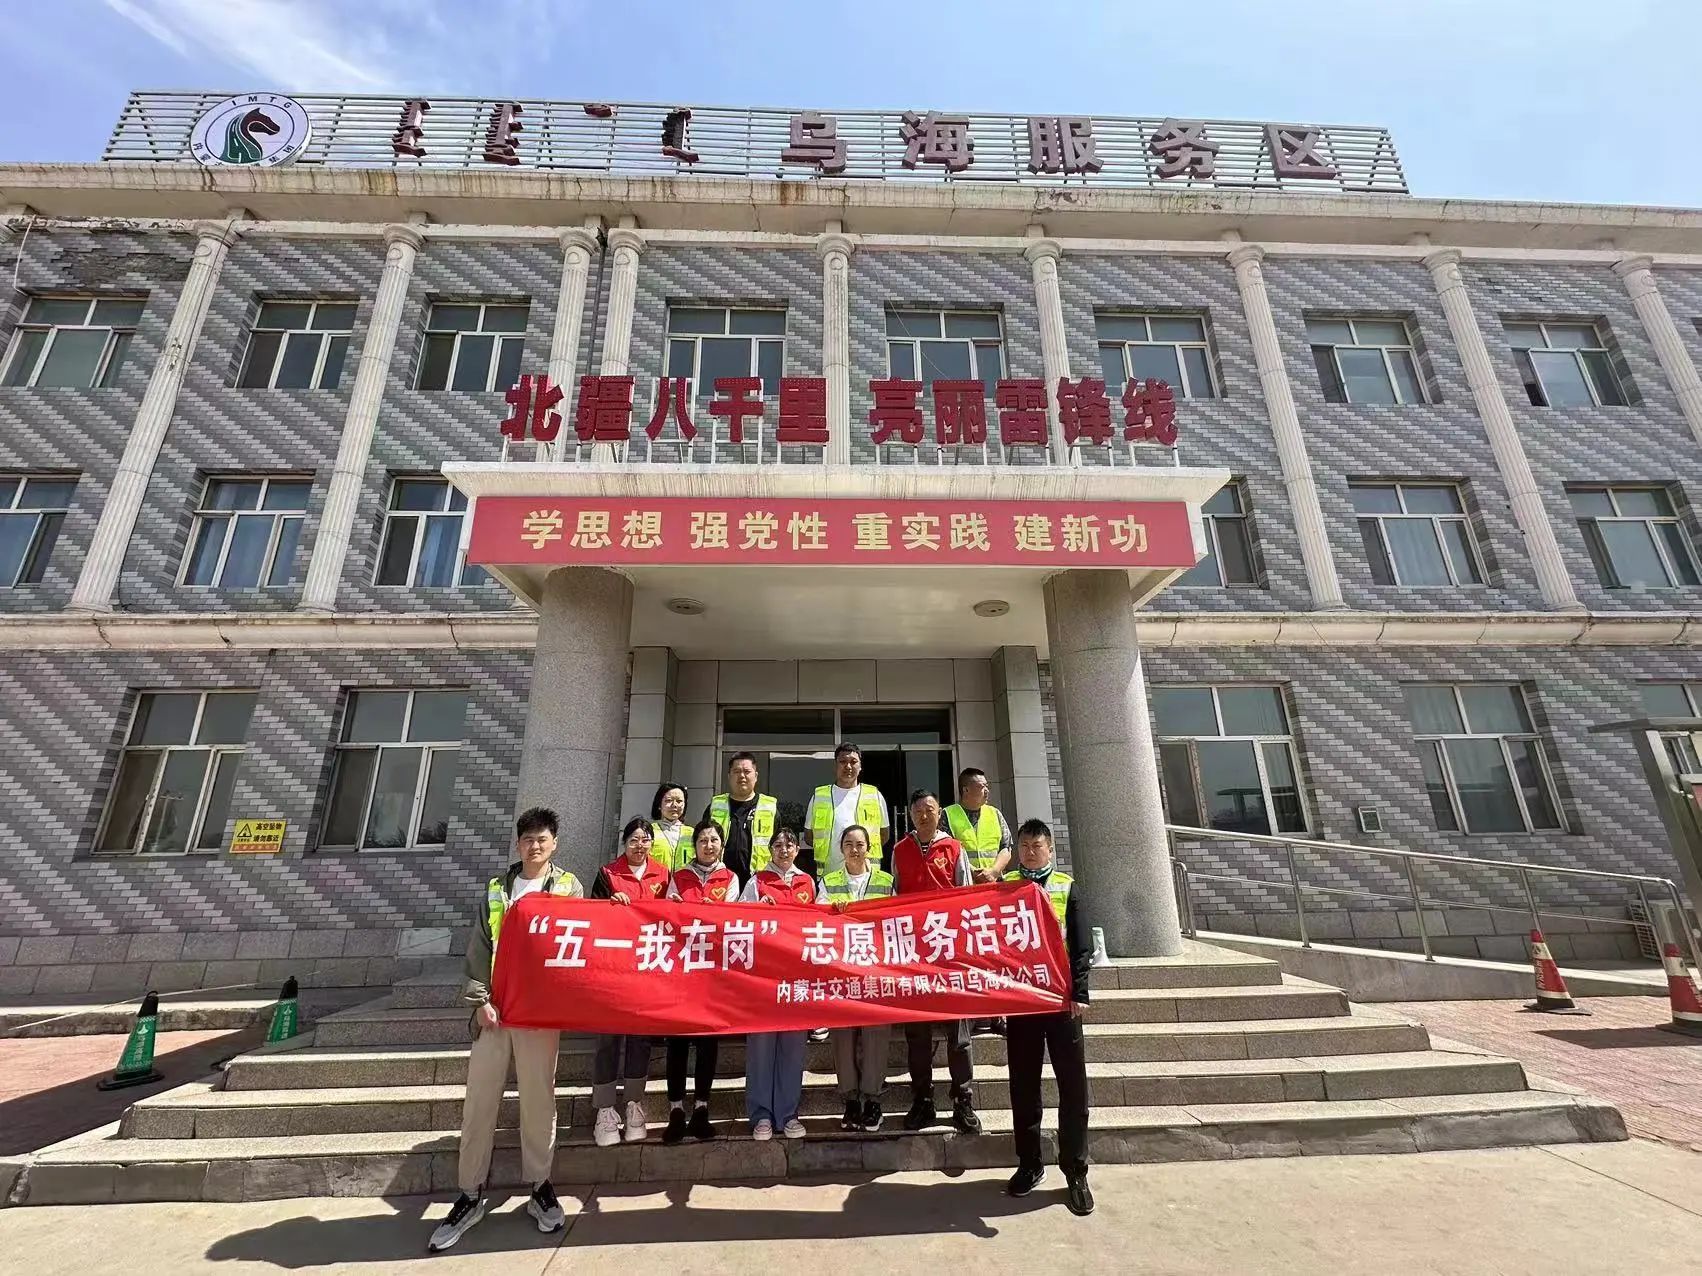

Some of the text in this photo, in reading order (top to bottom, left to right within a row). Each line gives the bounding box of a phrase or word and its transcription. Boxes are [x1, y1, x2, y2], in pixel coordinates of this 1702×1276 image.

[231, 96, 293, 109] IMTG
[782, 110, 1337, 179] 乌海服务区
[501, 375, 1179, 446] 北疆八千里 亮丽雷锋线
[520, 510, 1150, 555] 学思想 强党性 重实践 建新功
[801, 899, 1043, 968] 志愿服务活动
[776, 963, 1051, 1003] 内蒙古交通集团有限公司乌海分公司
